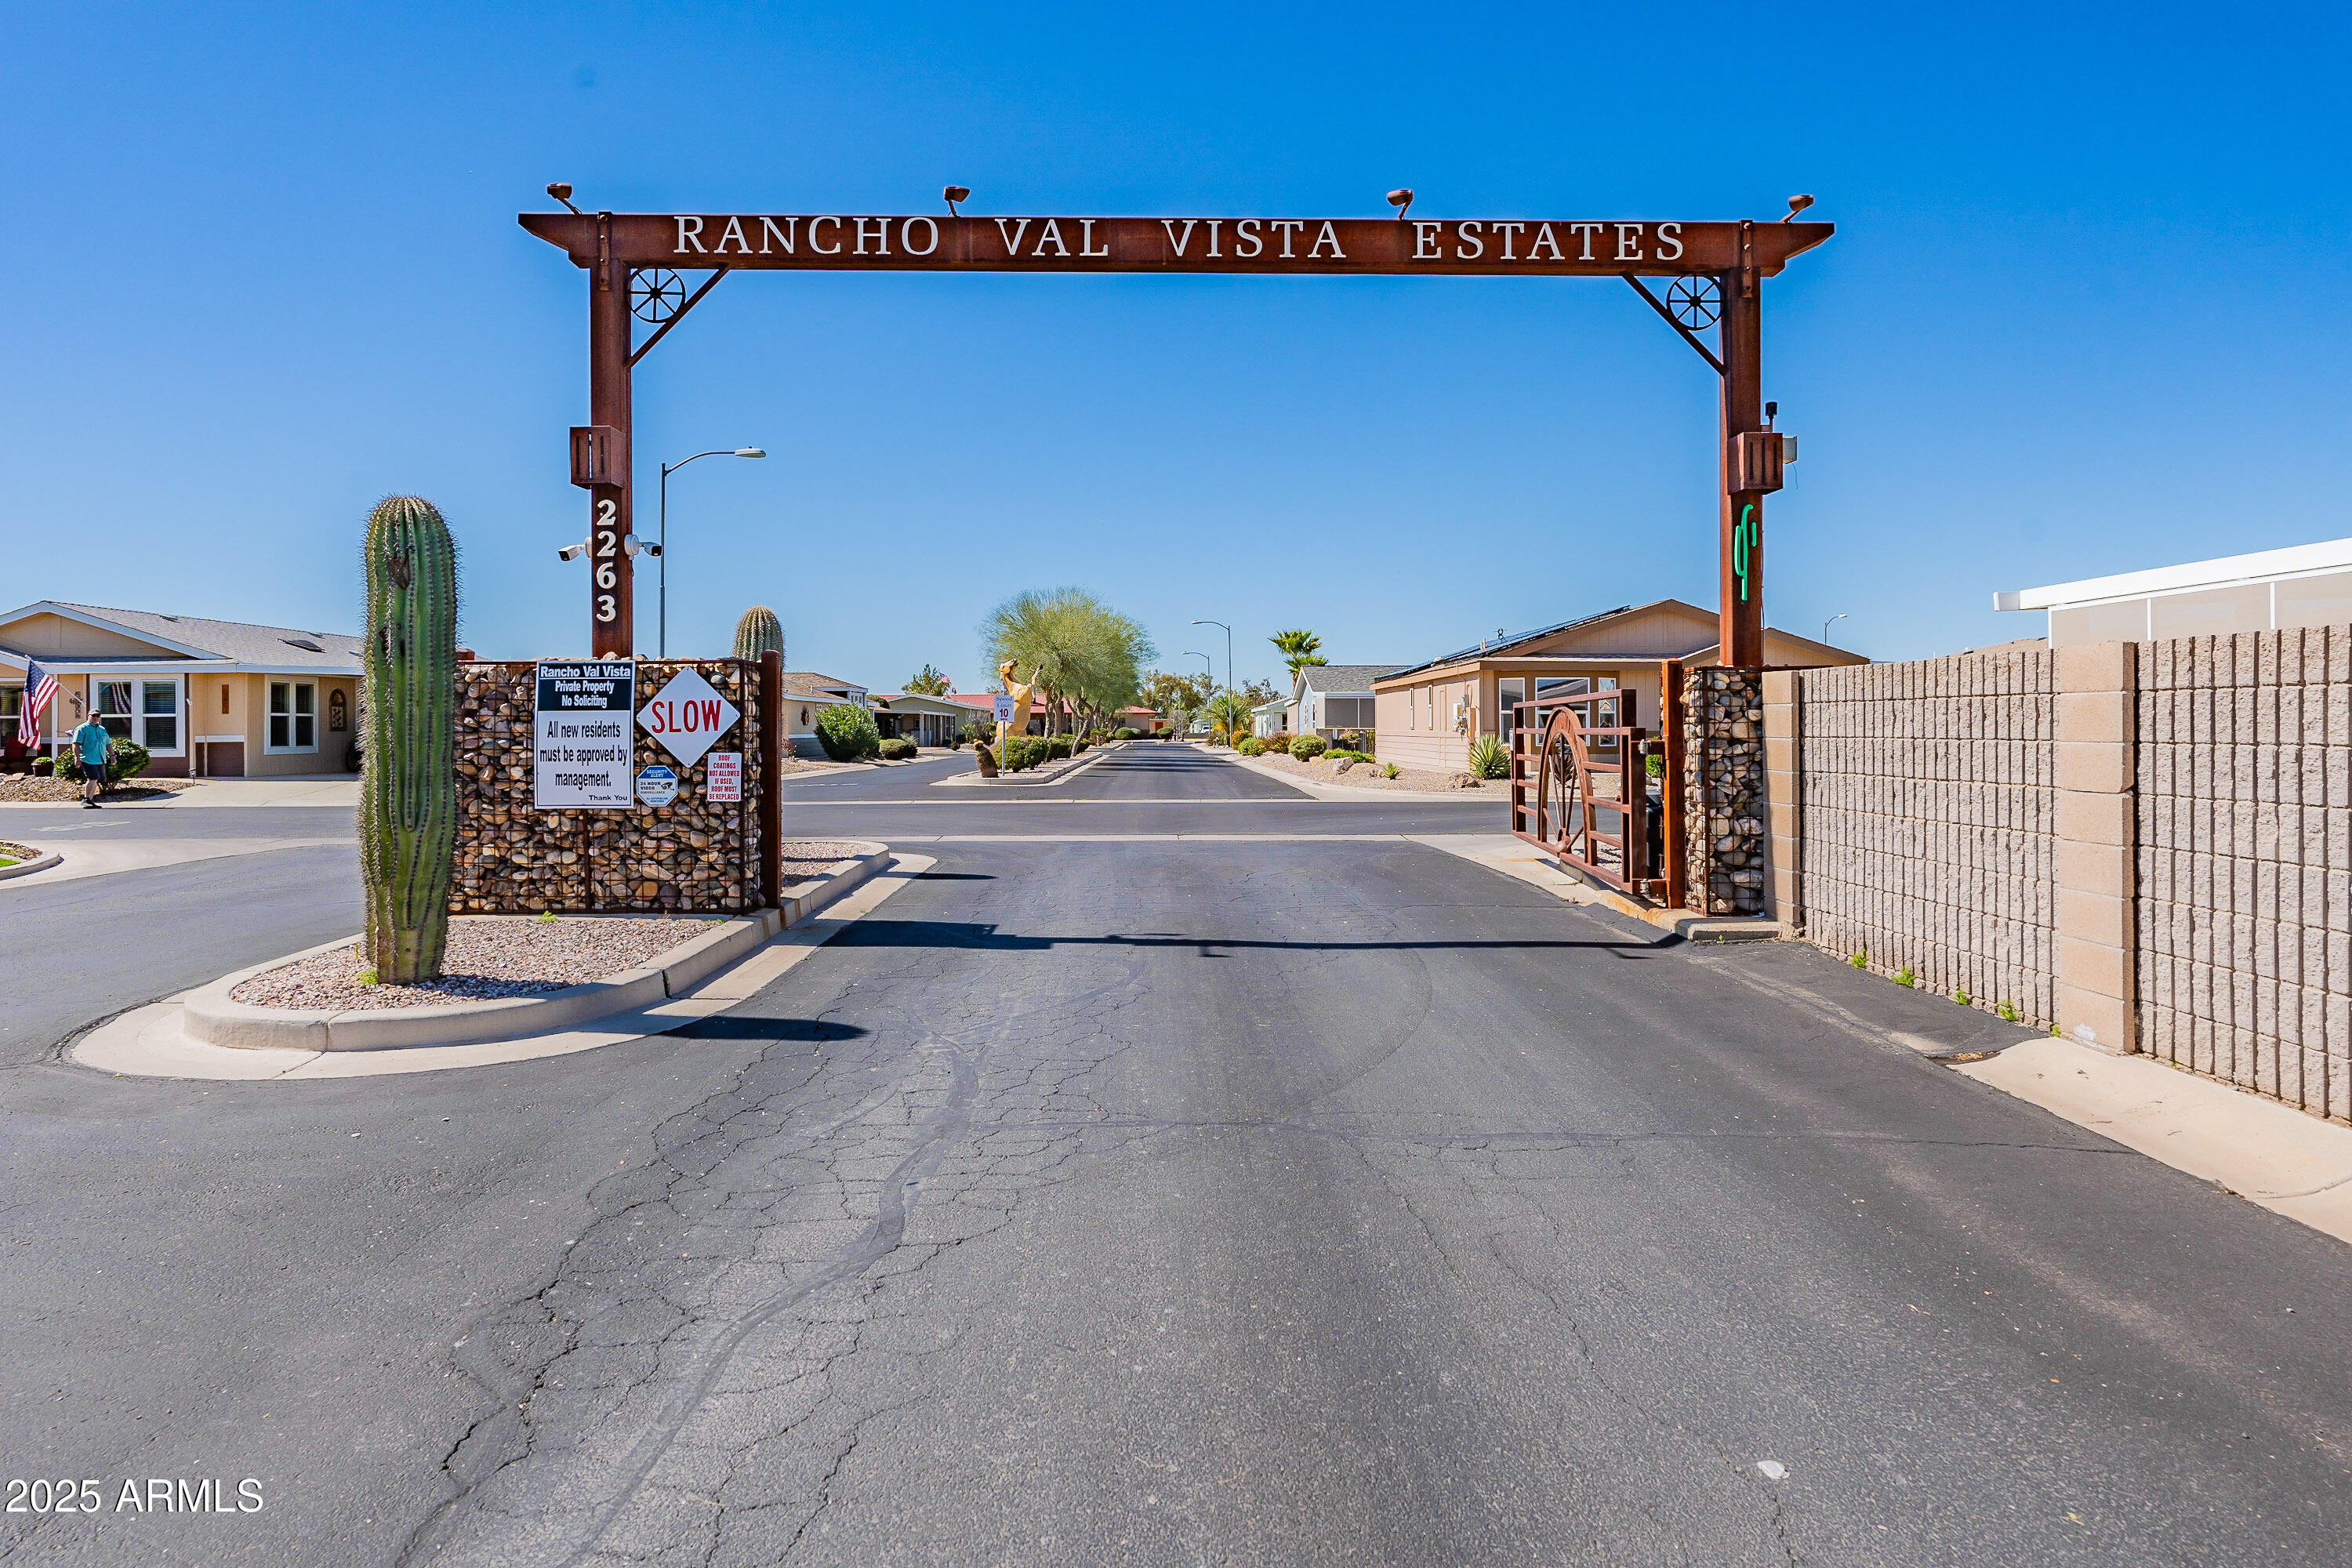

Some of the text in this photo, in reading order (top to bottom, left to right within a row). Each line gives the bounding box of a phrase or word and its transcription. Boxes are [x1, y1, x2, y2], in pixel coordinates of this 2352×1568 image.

[673, 216, 1684, 261] RANCHO VAL VISTA ESTATES
[596, 499, 616, 622] 2263
[540, 665, 631, 677] Rancho Val Vista
[555, 680, 615, 694] Private Property
[561, 695, 608, 709] No Soliciting
[652, 699, 721, 734] SLOW
[1000, 708, 1008, 717] 10
[547, 720, 621, 738] All new residents
[539, 745, 627, 766] must be approved by
[555, 770, 612, 791] management.
